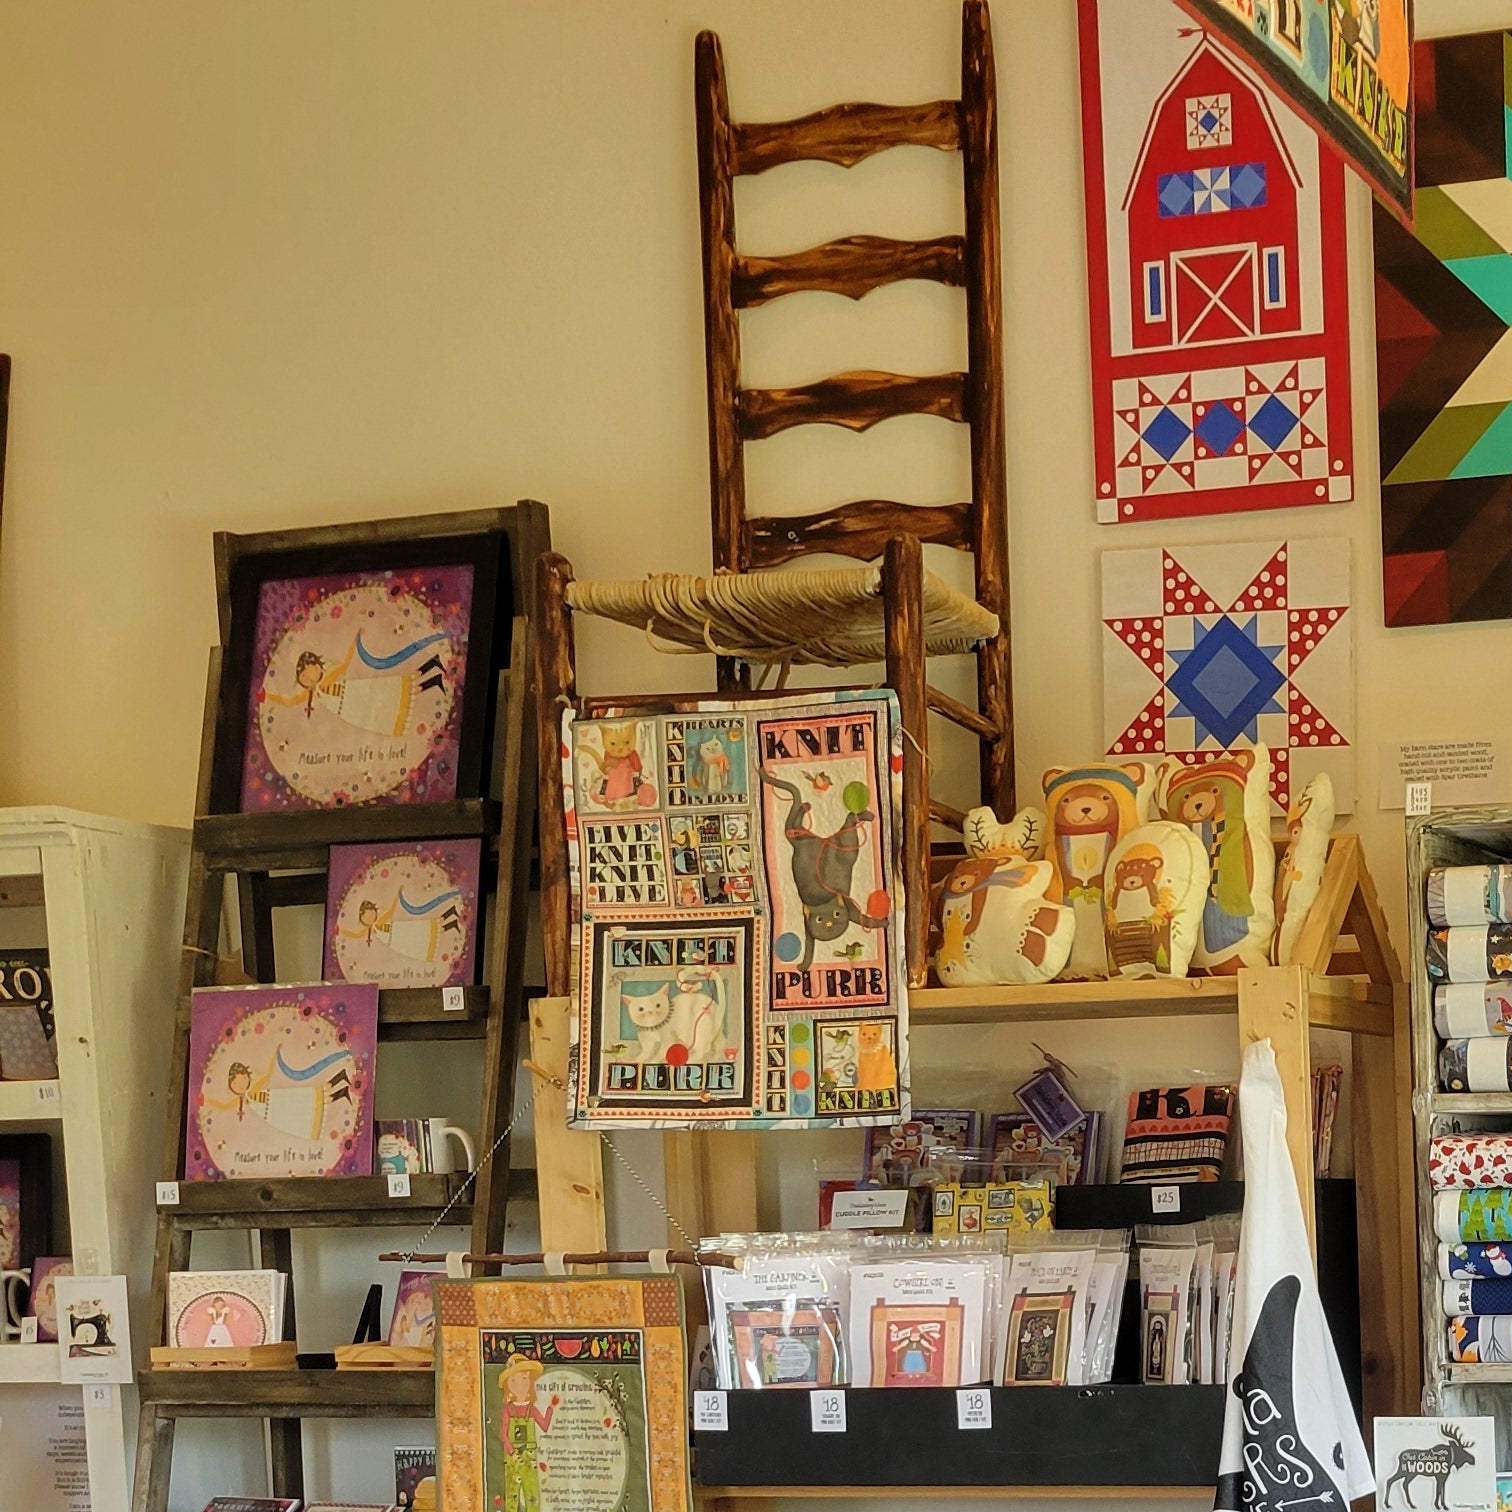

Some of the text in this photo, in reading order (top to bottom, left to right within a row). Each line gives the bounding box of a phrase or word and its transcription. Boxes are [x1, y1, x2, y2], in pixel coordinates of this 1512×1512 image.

[764, 723, 872, 758] KNIT
[588, 824, 651, 843] LIVE
[590, 844, 655, 864] KNIT
[590, 864, 659, 883] KNIT
[600, 885, 665, 902] LIVE
[775, 969, 886, 999] PURR
[608, 1064, 735, 1090] PURR
[234, 1151, 260, 1162] Measure
[263, 1154, 280, 1166] your
[282, 1150, 296, 1162] life
[161, 1188, 176, 1200] $15
[1157, 1193, 1174, 1205] $25
[704, 1396, 719, 1410] $18
[967, 1394, 983, 1410] $18
[1407, 1462, 1448, 1473] WOODS
